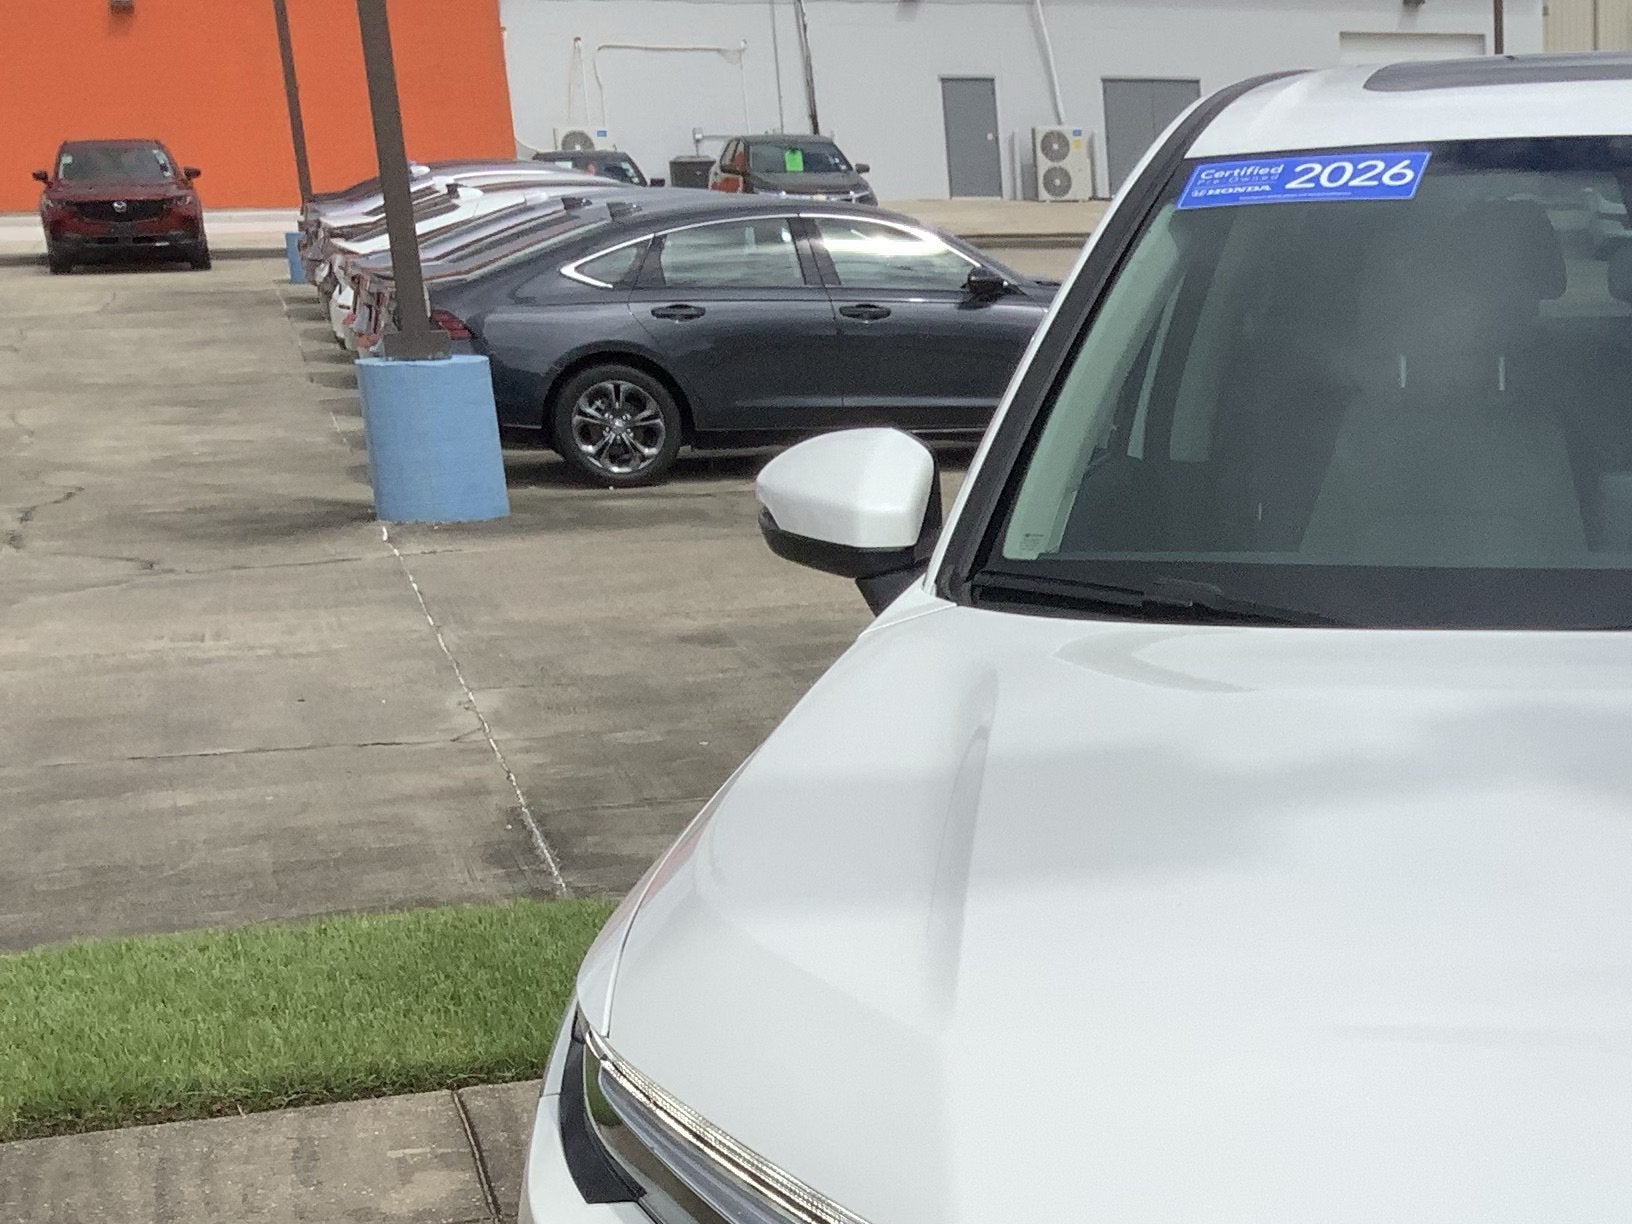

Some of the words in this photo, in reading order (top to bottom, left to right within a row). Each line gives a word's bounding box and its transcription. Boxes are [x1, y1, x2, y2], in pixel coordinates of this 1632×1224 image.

[1200, 164, 1284, 180] Certified
[1284, 159, 1414, 189] 2026
[1207, 185, 1271, 196] HONDA
